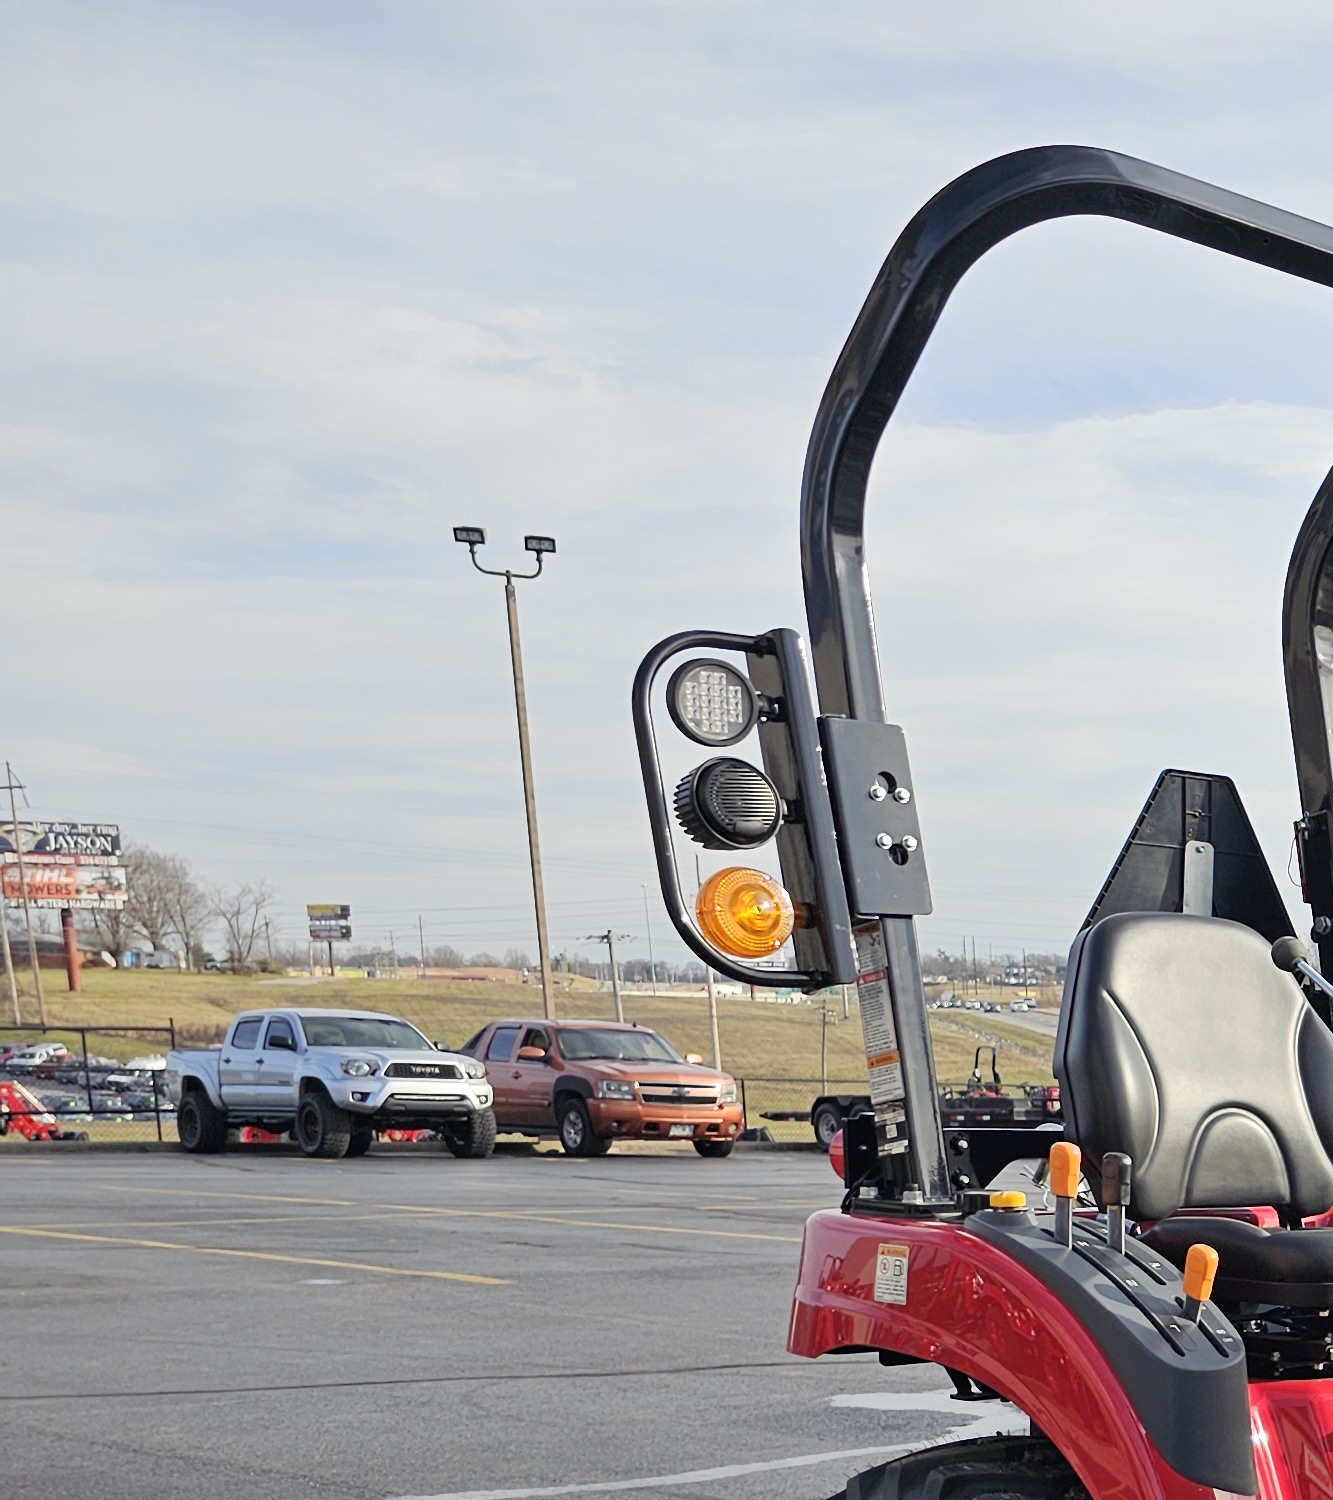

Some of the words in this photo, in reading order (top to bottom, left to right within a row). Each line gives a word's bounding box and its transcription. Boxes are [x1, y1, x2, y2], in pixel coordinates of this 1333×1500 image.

[46, 833, 112, 852] JAYSON
[11, 884, 71, 895] MOWERS
[412, 1066, 440, 1074] TOYOTA
